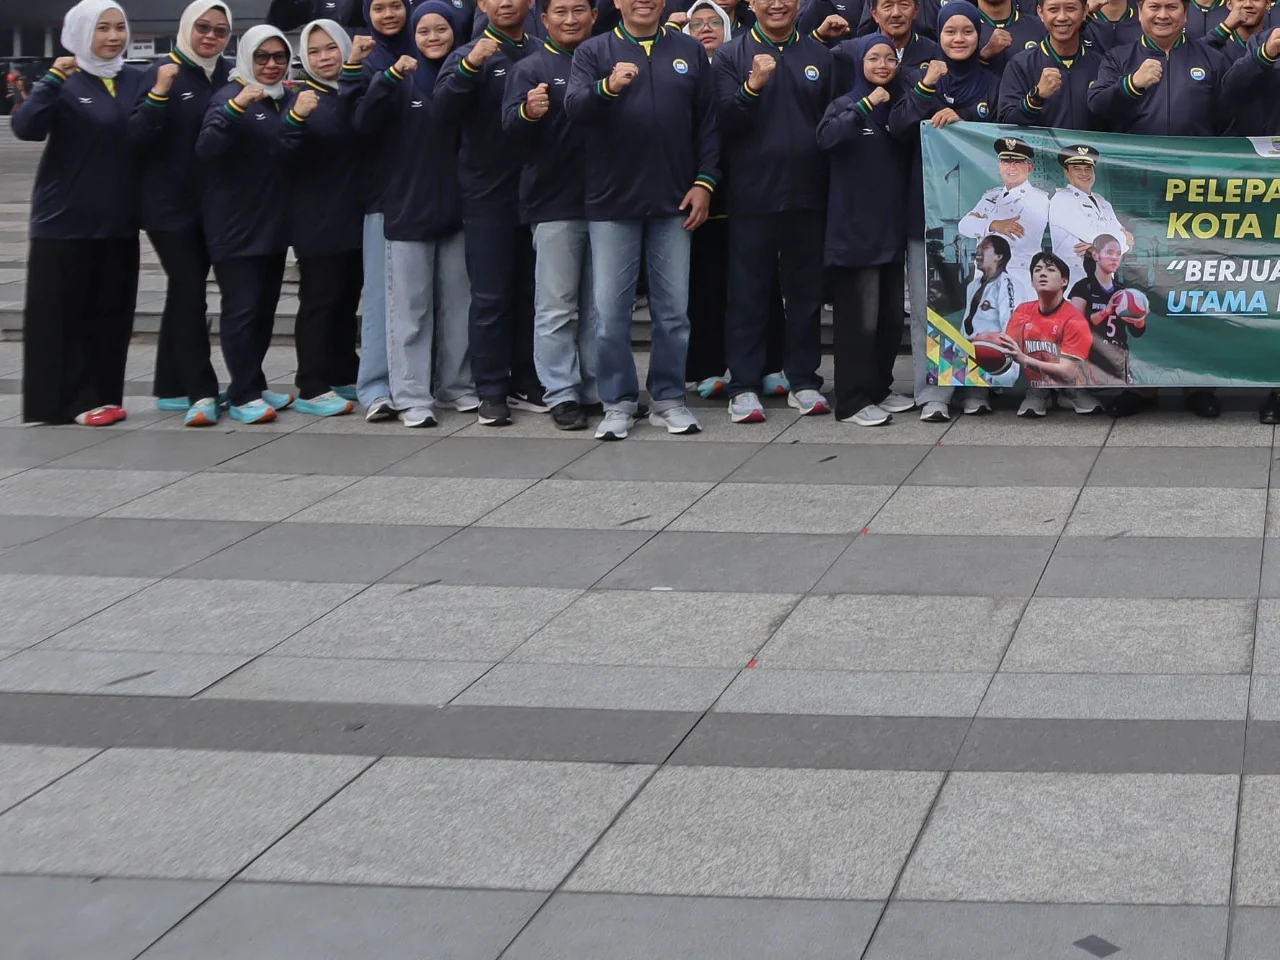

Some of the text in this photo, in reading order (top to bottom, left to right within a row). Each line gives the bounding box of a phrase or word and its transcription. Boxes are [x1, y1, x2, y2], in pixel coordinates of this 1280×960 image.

[1166, 212, 1262, 239] KOTA
[1166, 290, 1268, 314] UTAMA
[1106, 315, 1117, 338] 5
